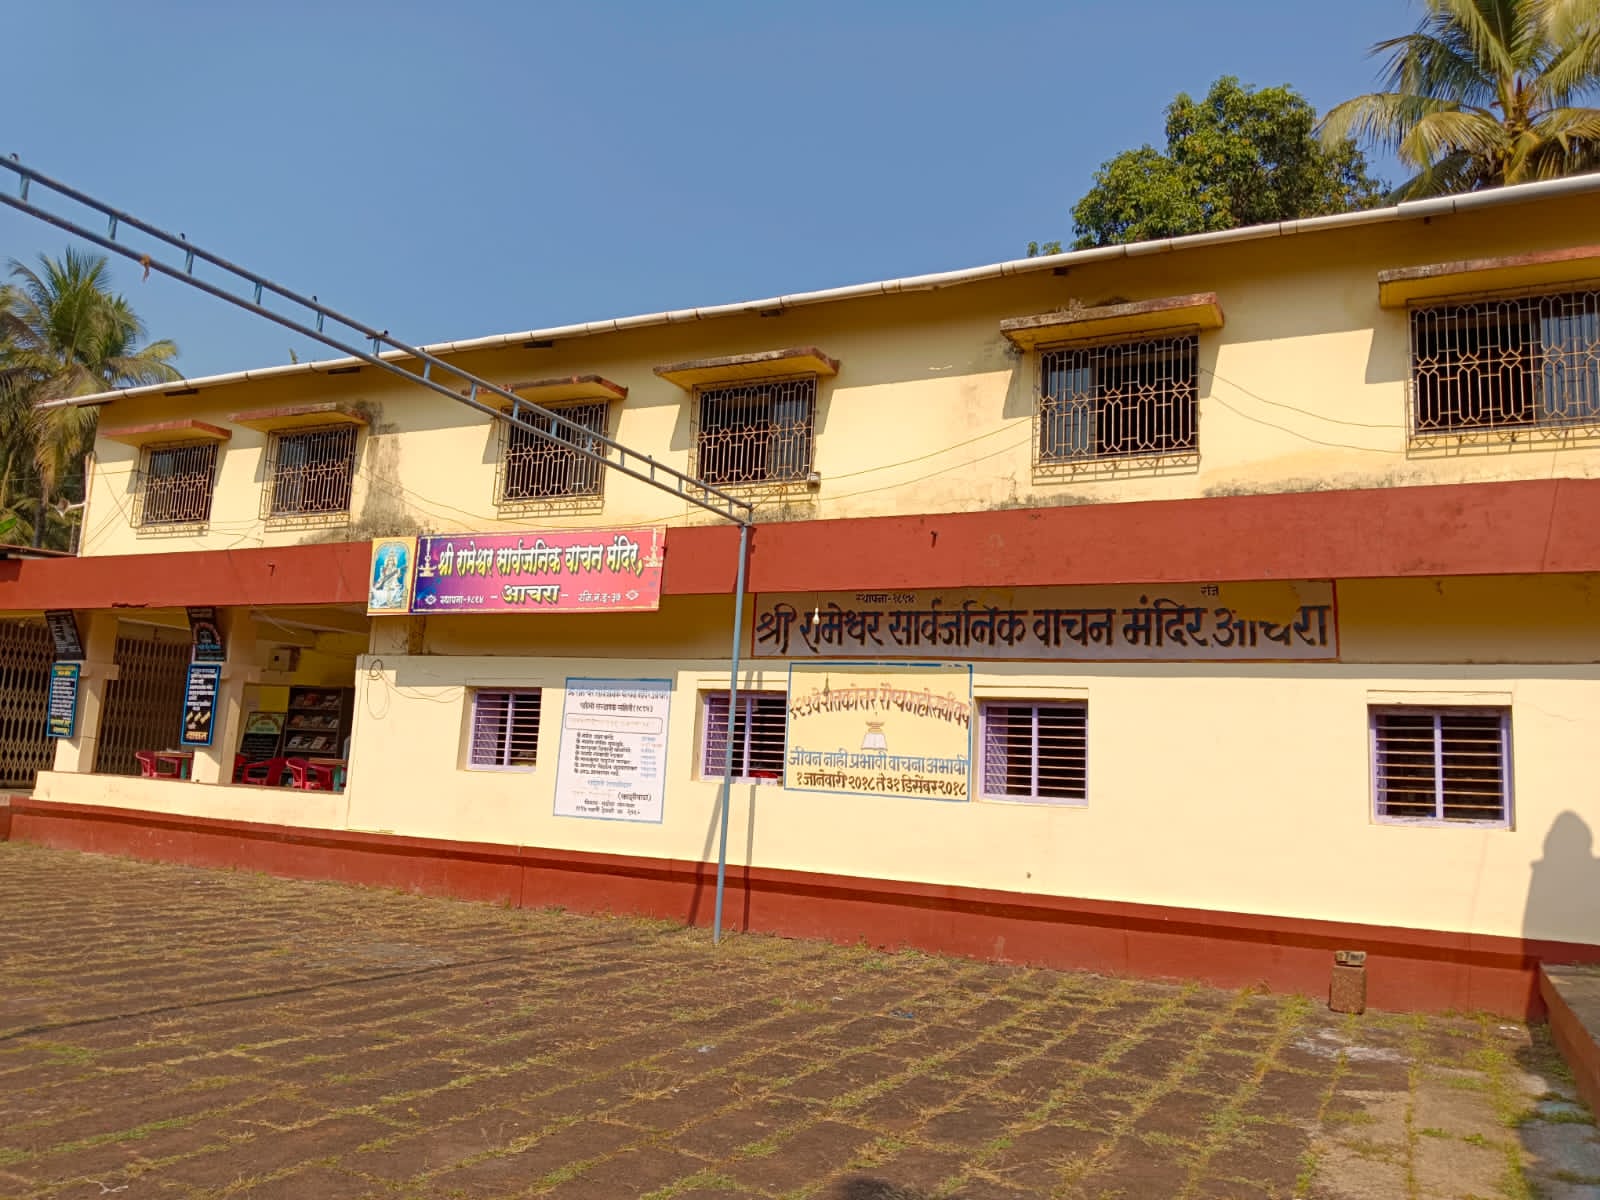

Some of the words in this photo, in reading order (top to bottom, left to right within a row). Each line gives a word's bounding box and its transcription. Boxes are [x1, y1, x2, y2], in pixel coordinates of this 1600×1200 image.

[438, 542, 454, 576] श्री
[457, 540, 494, 577] रामेश्वर
[496, 538, 562, 577] सार्वजनिक
[565, 544, 603, 574] वाचन
[755, 602, 797, 655] श्री
[799, 602, 885, 654] रामेश्वर
[887, 598, 1028, 648] सार्वजनिक
[1032, 606, 1117, 648] वाचन
[788, 746, 822, 767] जीवन
[823, 748, 848, 769] नाही
[888, 755, 925, 773] वाचना
[797, 772, 803, 786] १
[847, 775, 876, 791] २०१८
[886, 776, 901, 792] ३१
[938, 780, 967, 797] २०१८
